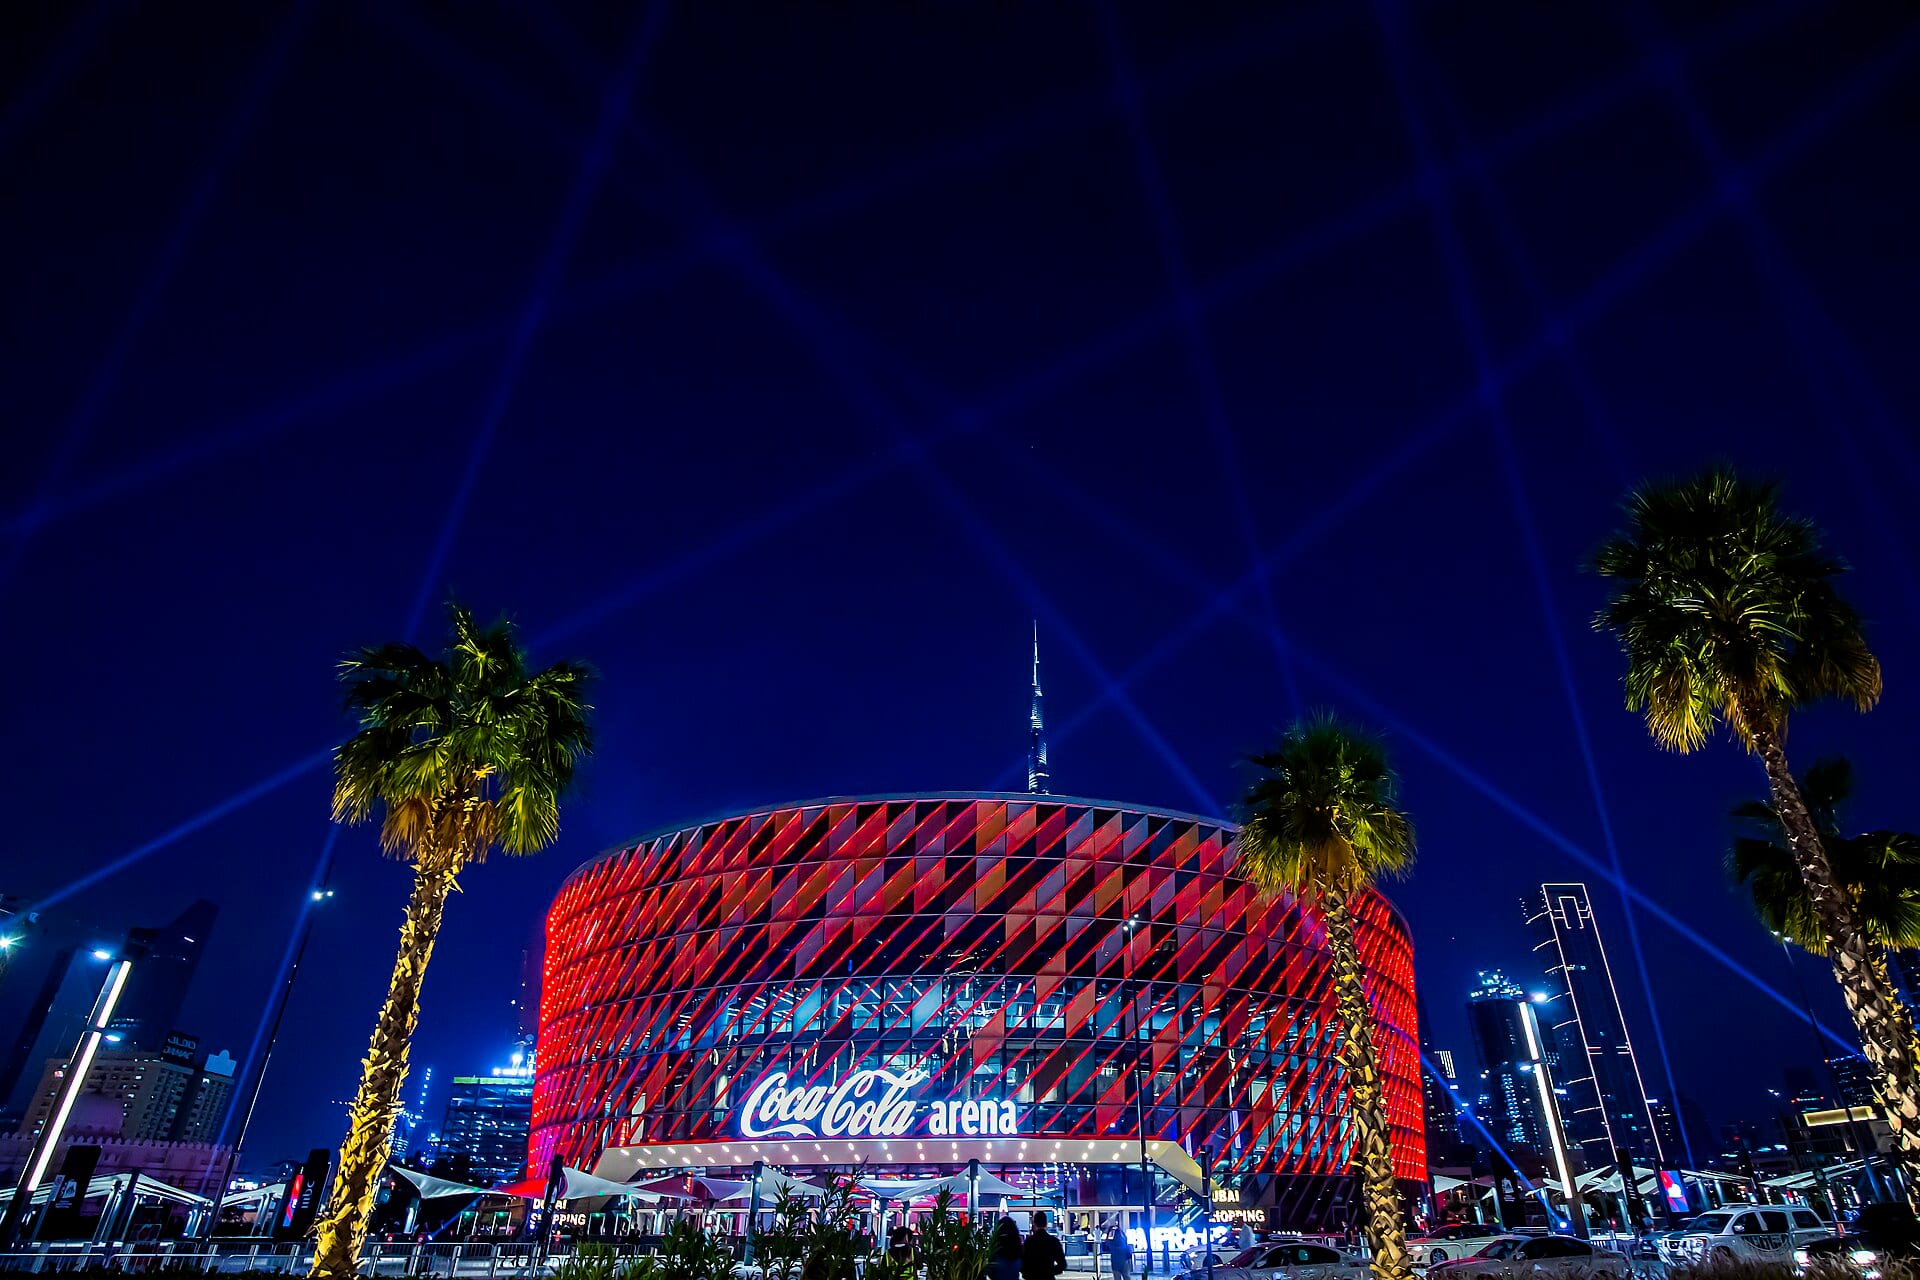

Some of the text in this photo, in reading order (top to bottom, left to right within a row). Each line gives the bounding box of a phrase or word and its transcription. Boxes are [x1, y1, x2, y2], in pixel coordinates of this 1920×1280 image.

[740, 1069, 1018, 1138] Coca-Cola arena
[1211, 1189, 1240, 1203] UBAI
